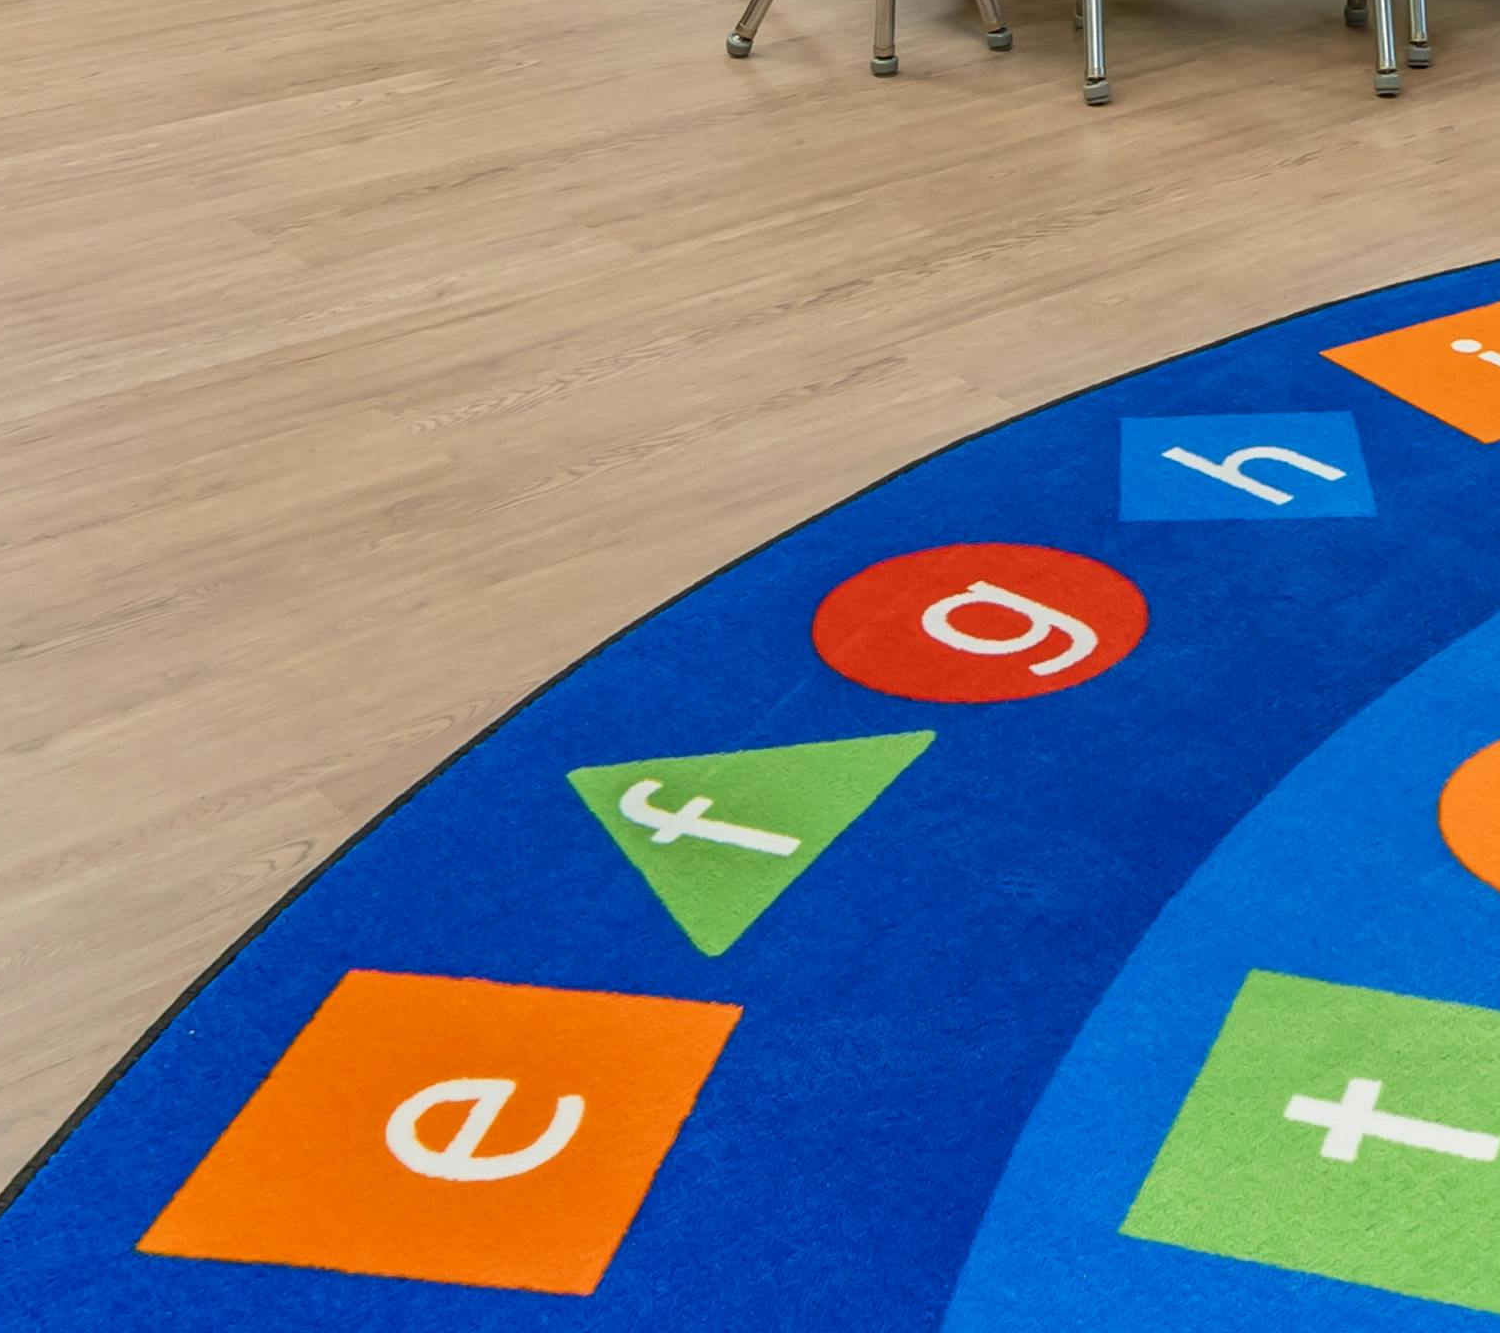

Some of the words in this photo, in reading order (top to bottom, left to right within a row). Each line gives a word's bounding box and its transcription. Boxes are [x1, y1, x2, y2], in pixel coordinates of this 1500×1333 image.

[385, 1078, 585, 1182] e
[618, 779, 802, 858] f
[921, 580, 1098, 677] g
[1161, 445, 1346, 506] h
